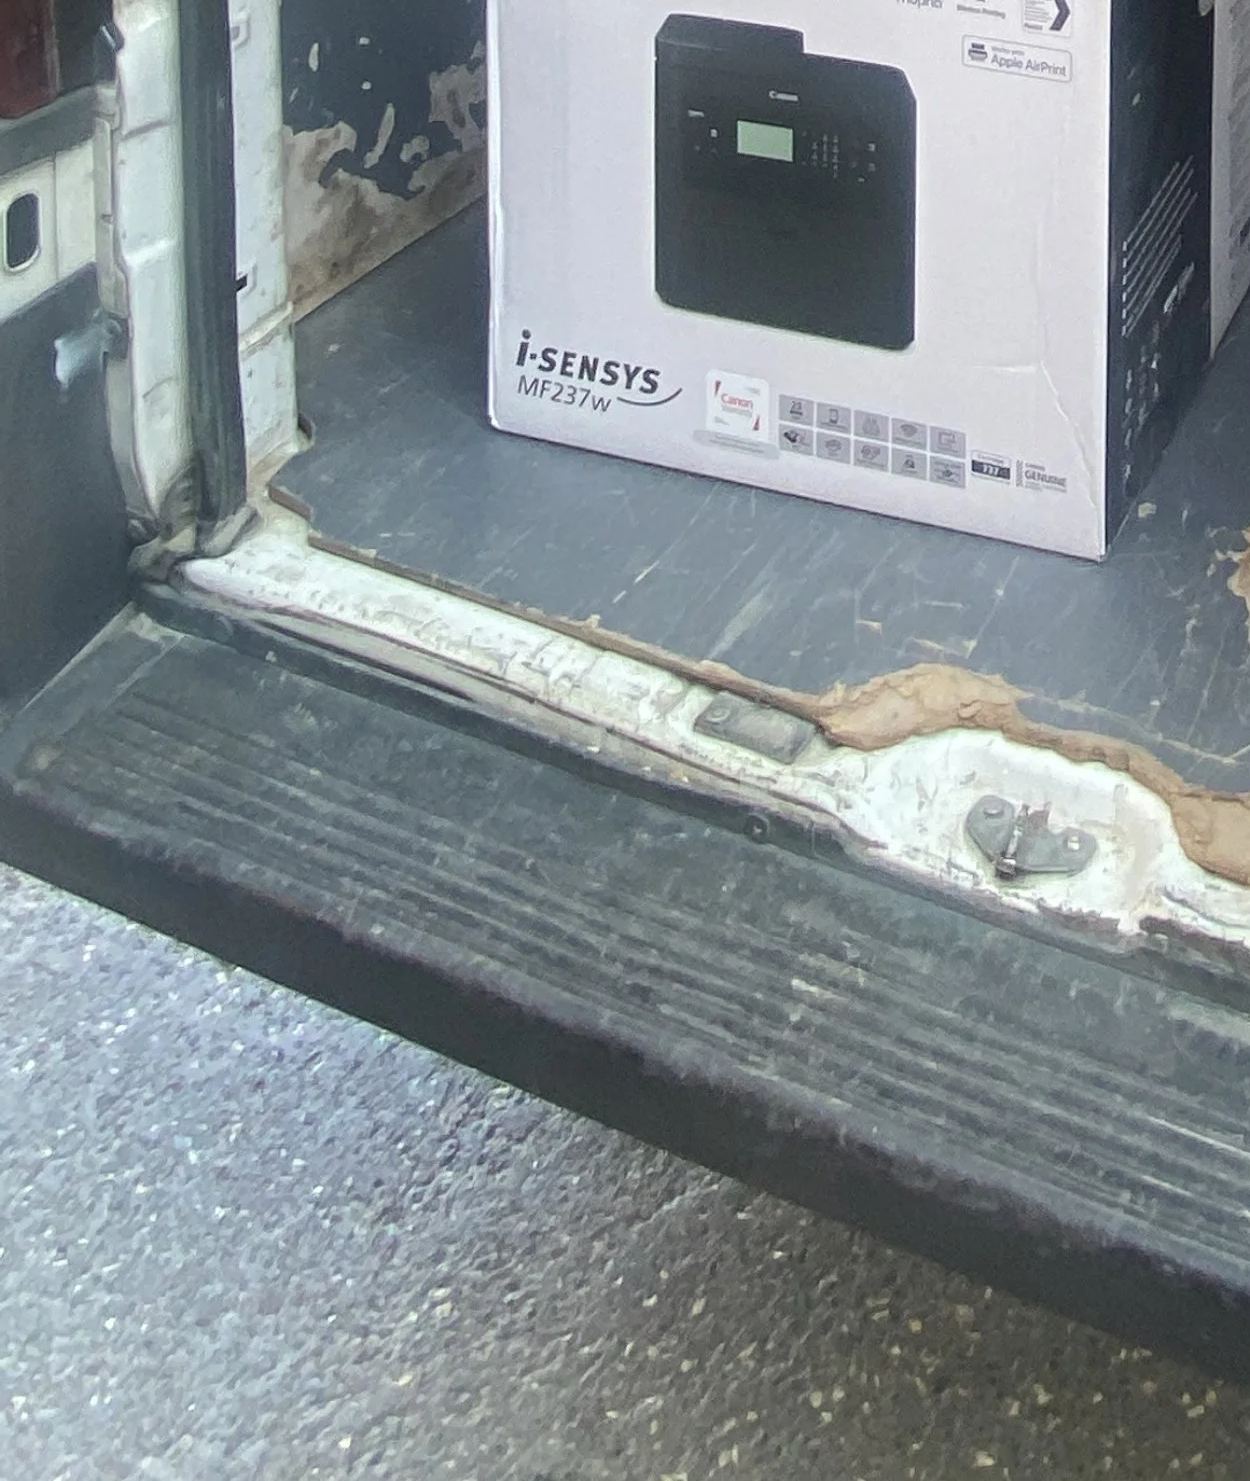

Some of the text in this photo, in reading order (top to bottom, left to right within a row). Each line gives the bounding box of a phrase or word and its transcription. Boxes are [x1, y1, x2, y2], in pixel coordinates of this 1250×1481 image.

[991, 54, 1067, 77] Apple AirPrint
[515, 329, 661, 395] i-SENSYS
[517, 374, 613, 413] MF237w
[721, 392, 754, 409] Canon
